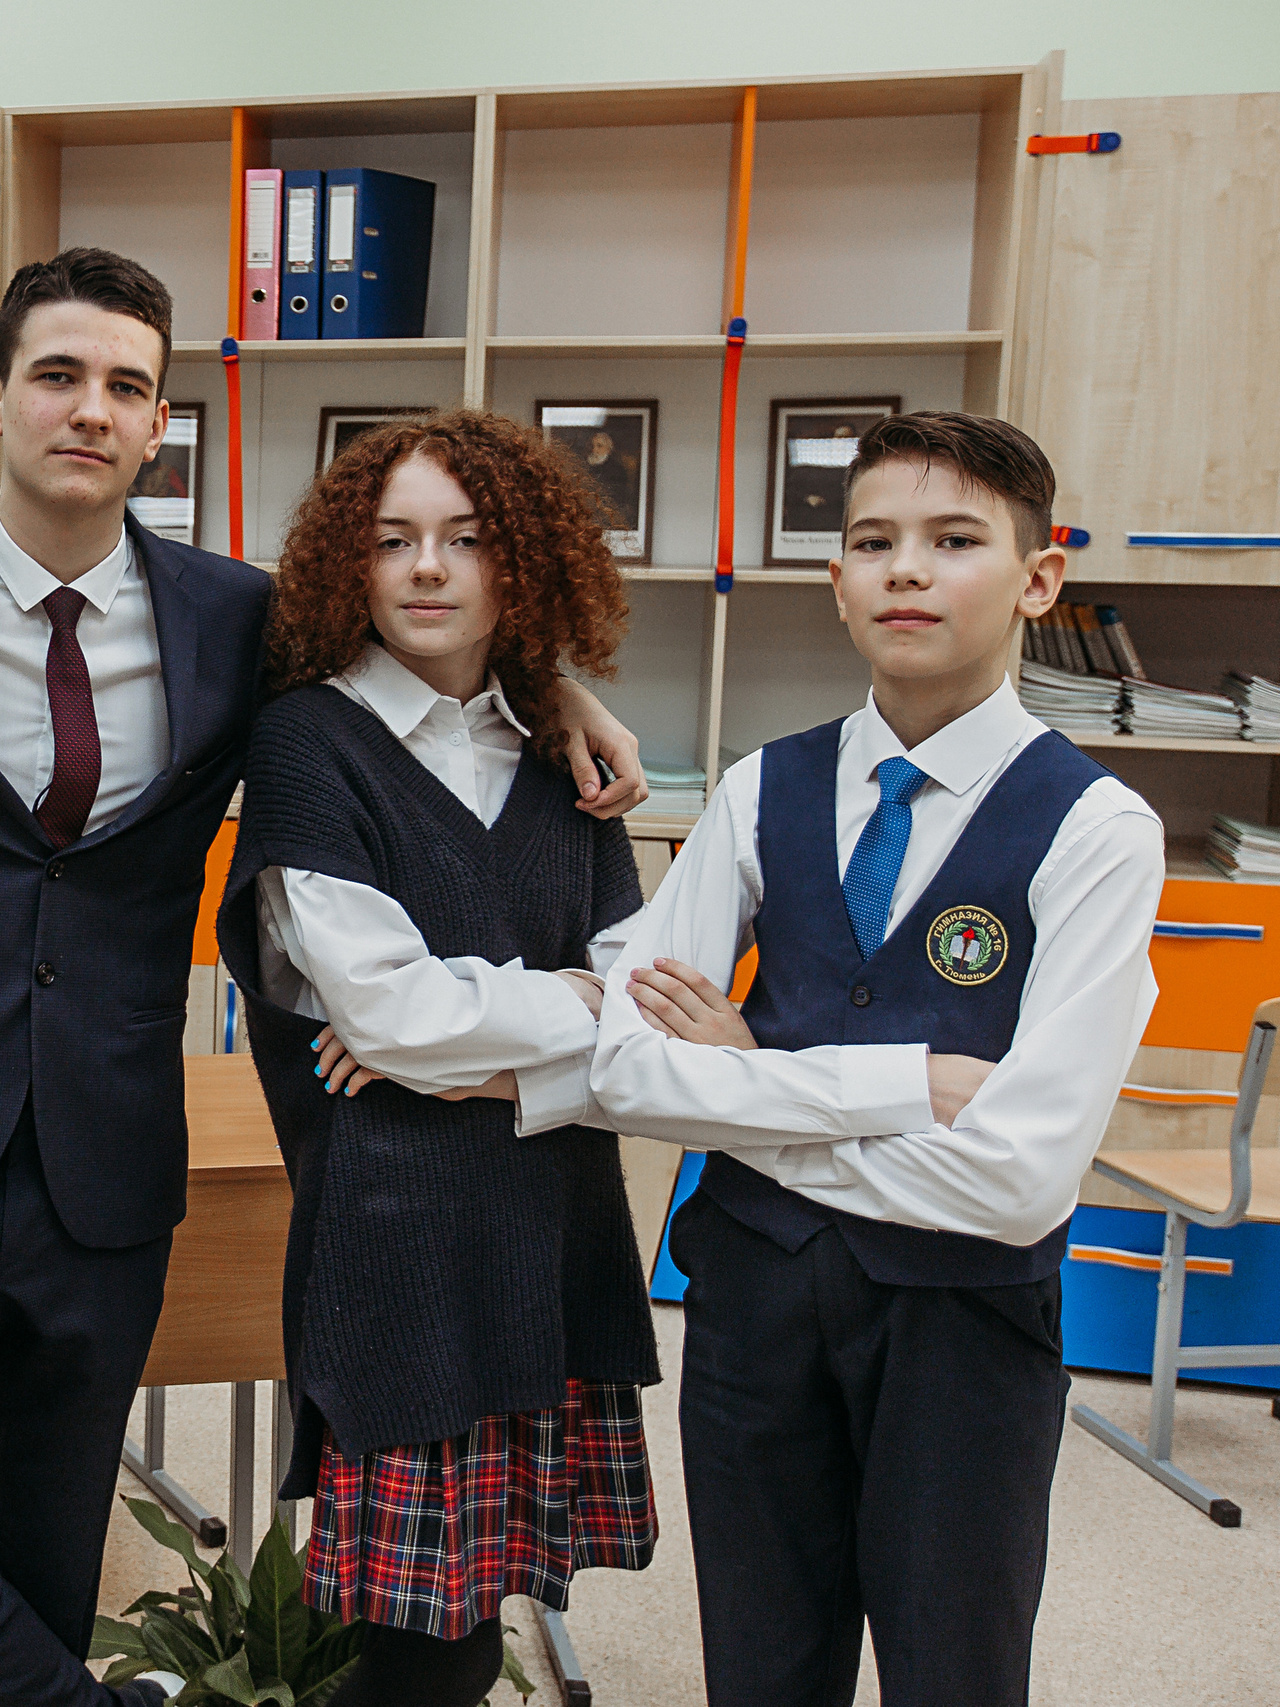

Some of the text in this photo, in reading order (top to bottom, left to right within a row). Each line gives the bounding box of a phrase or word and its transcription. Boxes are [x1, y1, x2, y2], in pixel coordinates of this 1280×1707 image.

[933, 911, 1002, 952] ГИМНАЗИЯ № 16
[945, 965, 986, 980] Тюмень
